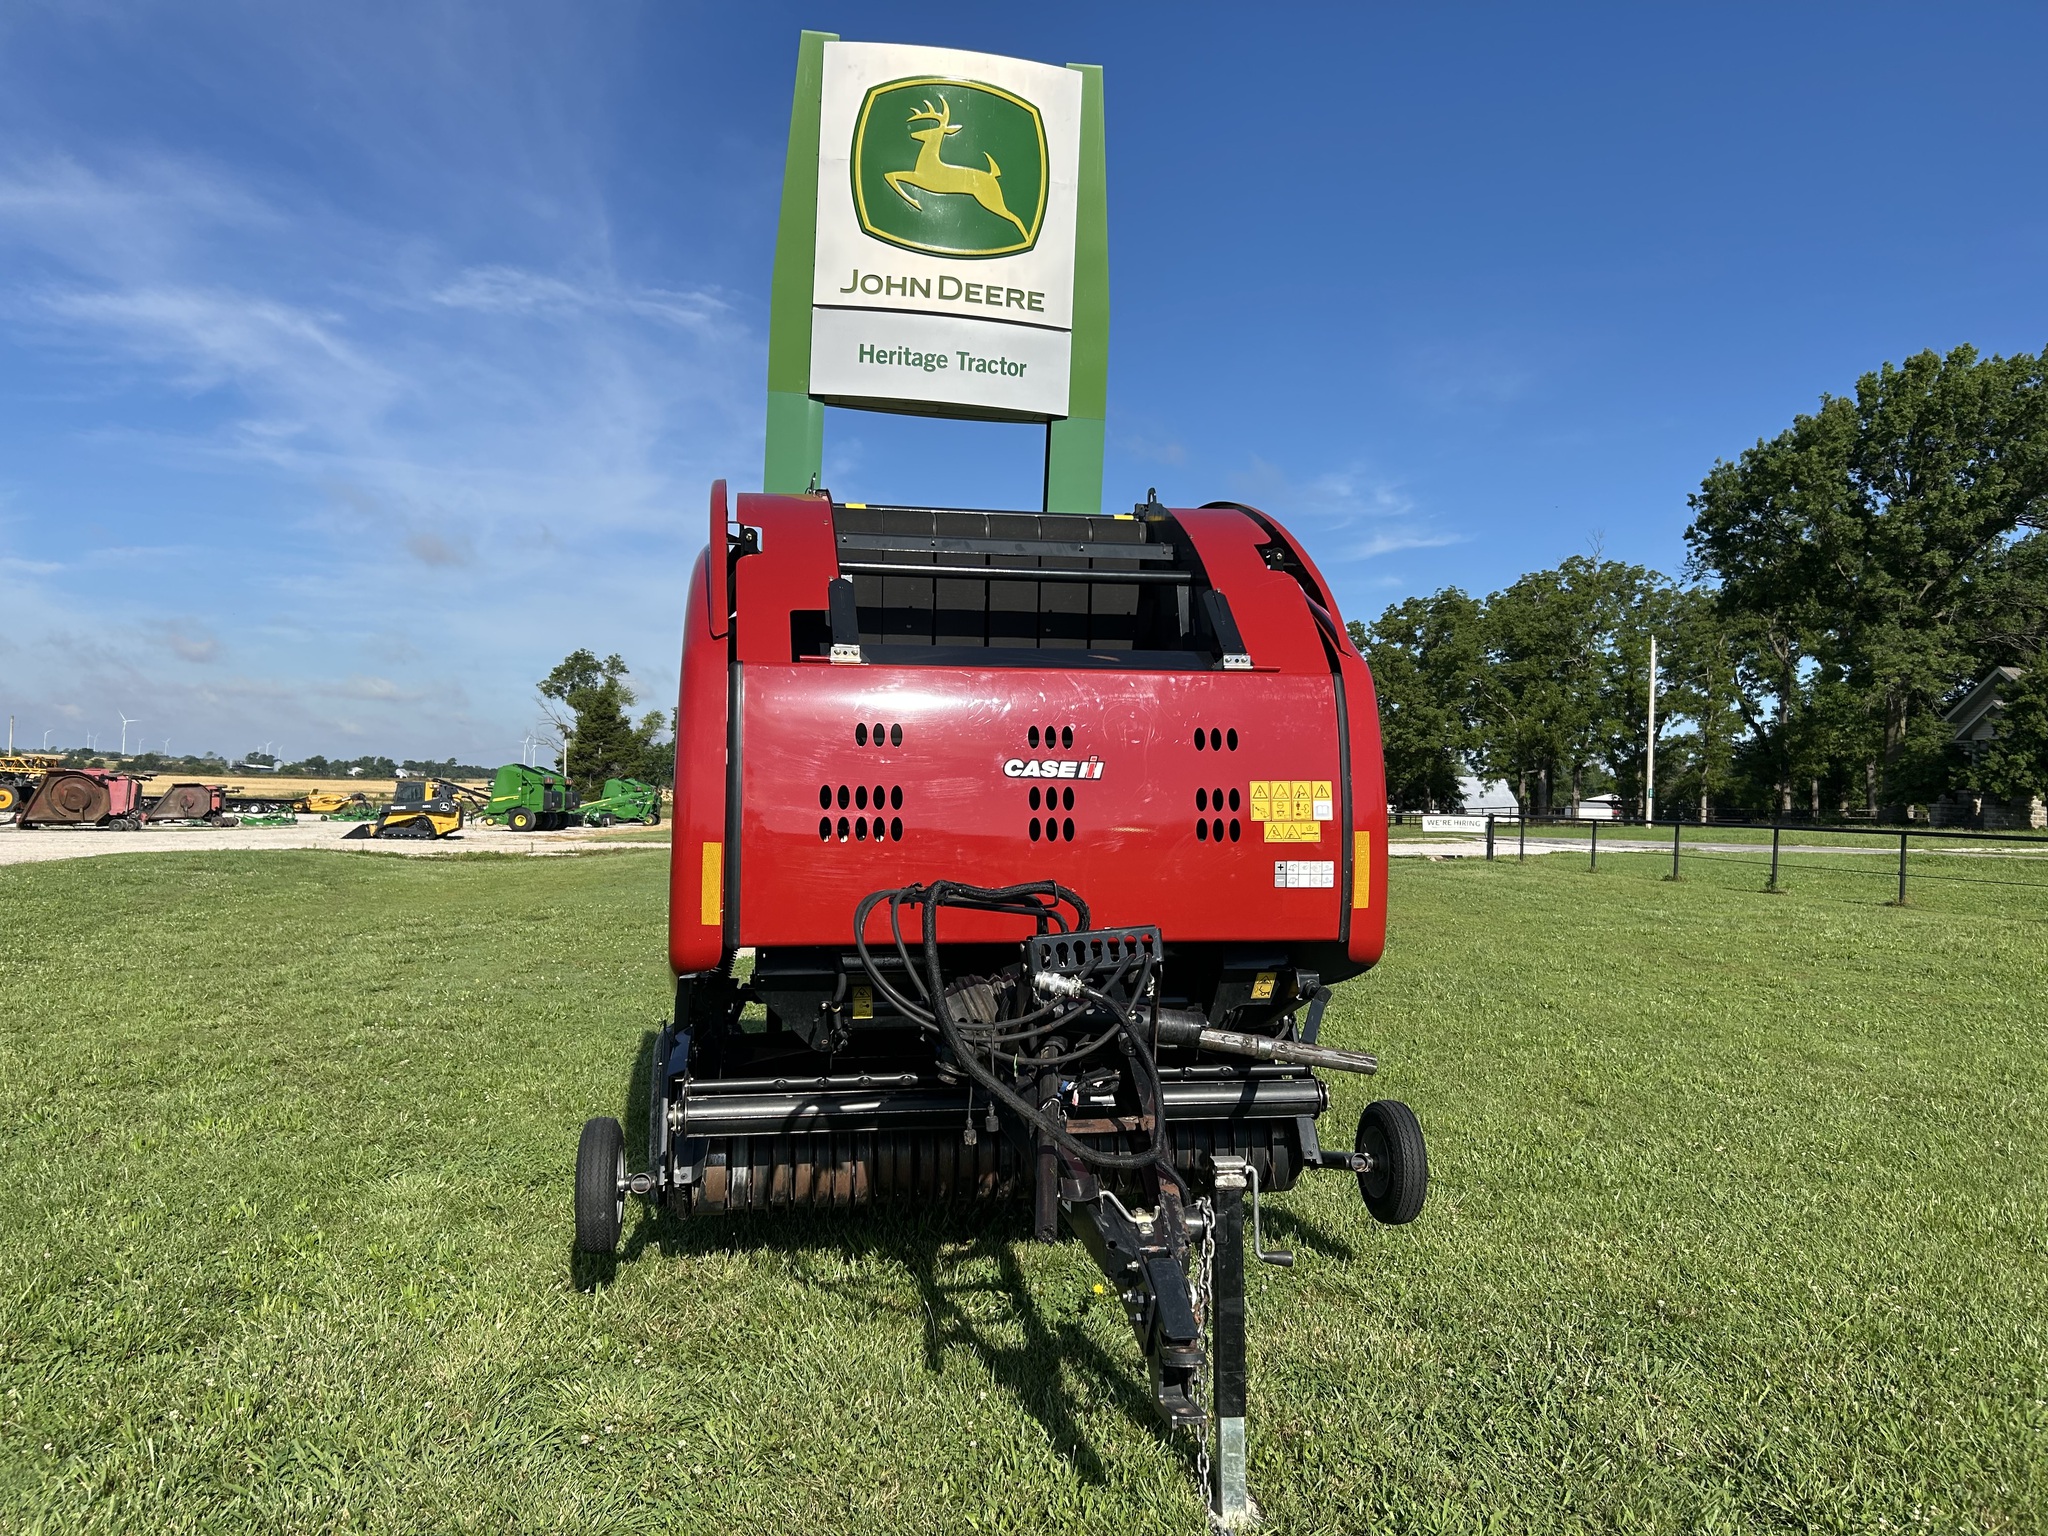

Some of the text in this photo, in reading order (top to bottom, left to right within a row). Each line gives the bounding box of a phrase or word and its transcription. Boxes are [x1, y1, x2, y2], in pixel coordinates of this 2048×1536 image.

[840, 269, 1045, 312] JOHN DEERE
[859, 343, 1027, 378] Heritage Tractor
[1004, 758, 1078, 778] CASE
